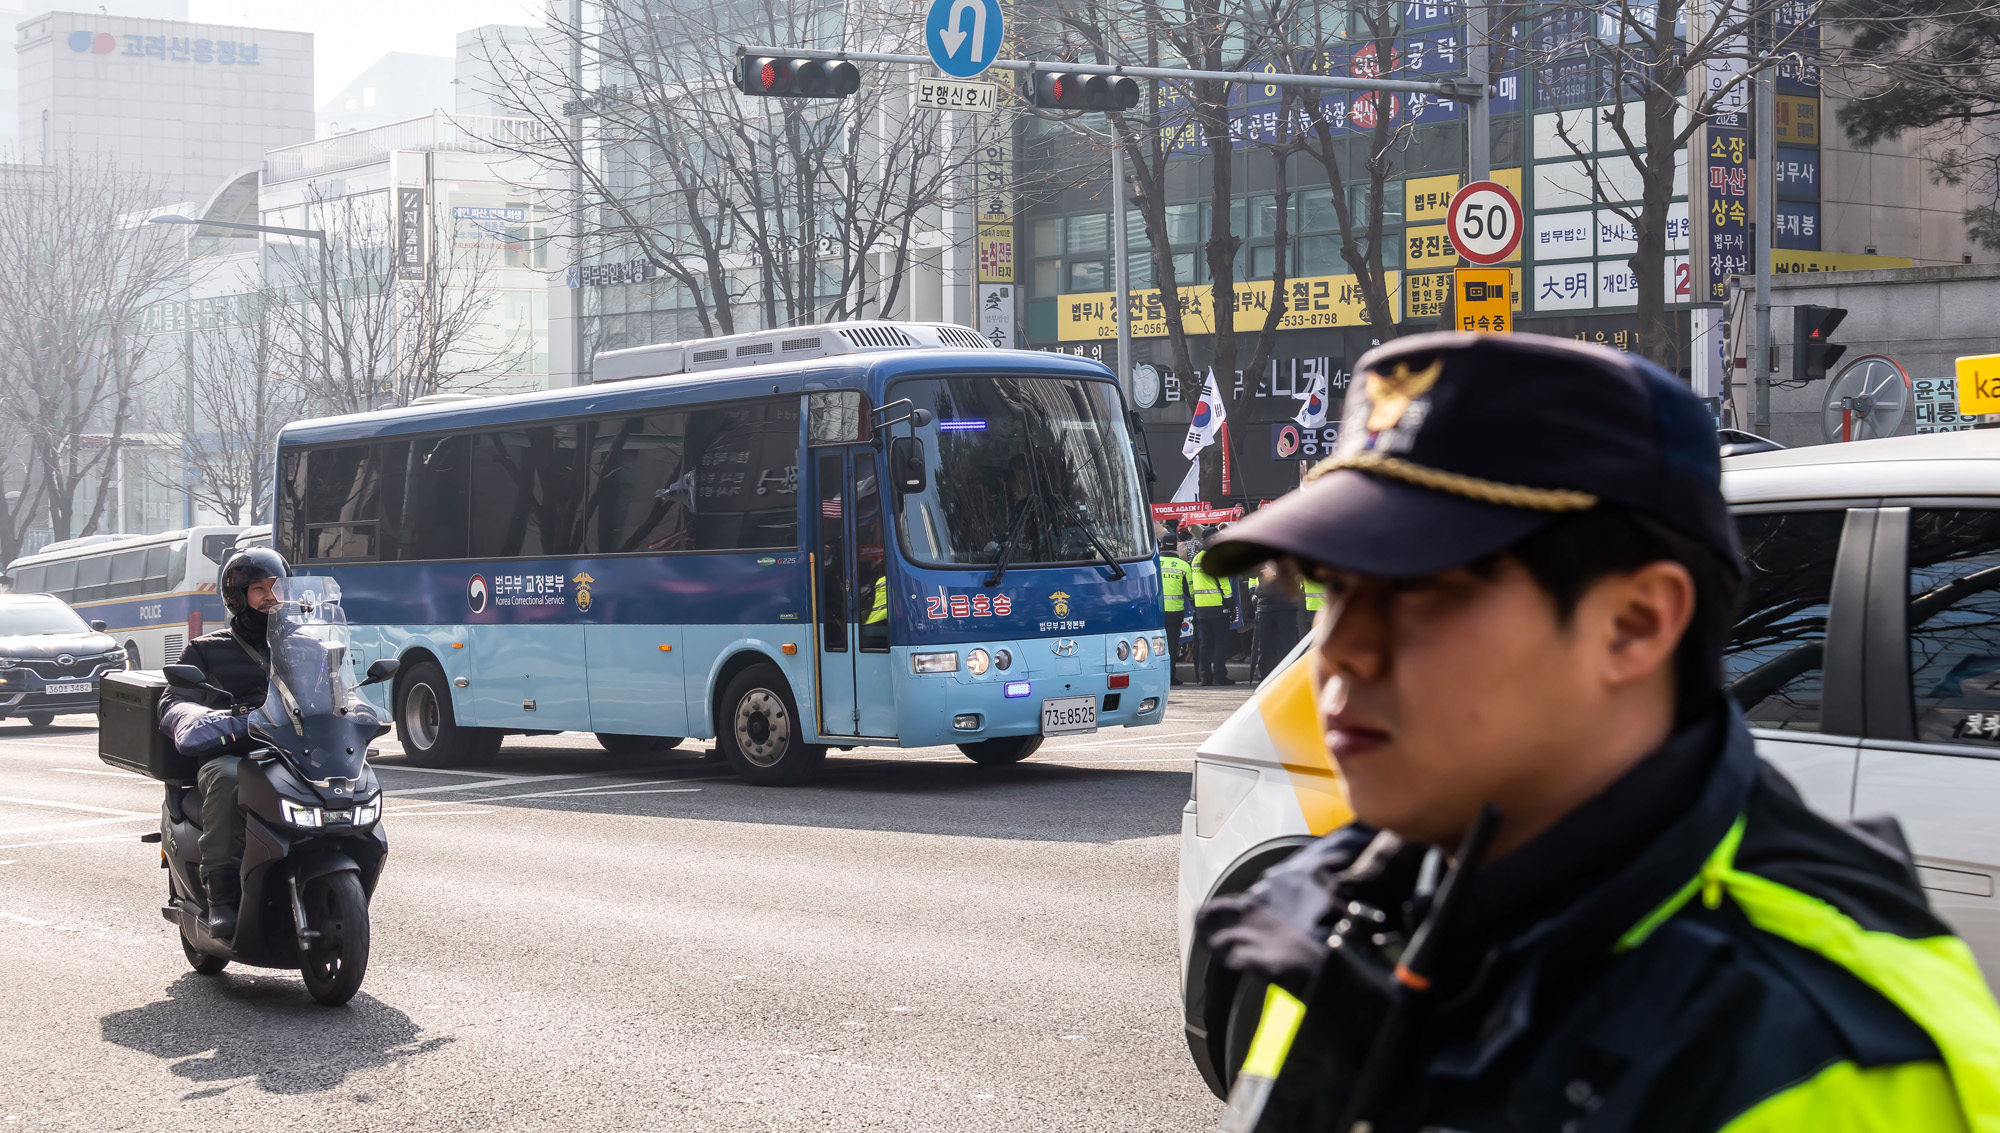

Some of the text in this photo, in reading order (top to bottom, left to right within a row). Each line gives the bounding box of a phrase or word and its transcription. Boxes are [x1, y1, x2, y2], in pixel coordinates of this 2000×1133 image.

[121, 34, 261, 66] 고려신용정보
[920, 85, 993, 109] 보행신호시
[1710, 136, 1746, 165] 소장
[1710, 166, 1747, 195] 파산
[1414, 192, 1451, 211] 법무사
[1463, 204, 1508, 240] 50
[1711, 199, 1746, 227] 상속
[1540, 228, 1586, 243] 법무법인
[1713, 233, 1744, 251] 법무사
[998, 242, 1012, 263] 전문
[998, 266, 1012, 277] 타자
[1540, 272, 1588, 300] 大明
[1072, 302, 1103, 322] 법무사
[1463, 315, 1505, 332] 단속중
[988, 326, 1007, 348] 송
[1914, 380, 1959, 400] 윤석
[495, 574, 565, 594] 법무부 교정본부
[495, 594, 565, 606] Korea Correctional Service
[926, 593, 1012, 620] 긴급호송
[139, 604, 162, 620] POLICE
[70, 683, 89, 692] 3482
[1045, 706, 1095, 726] 73도8525
